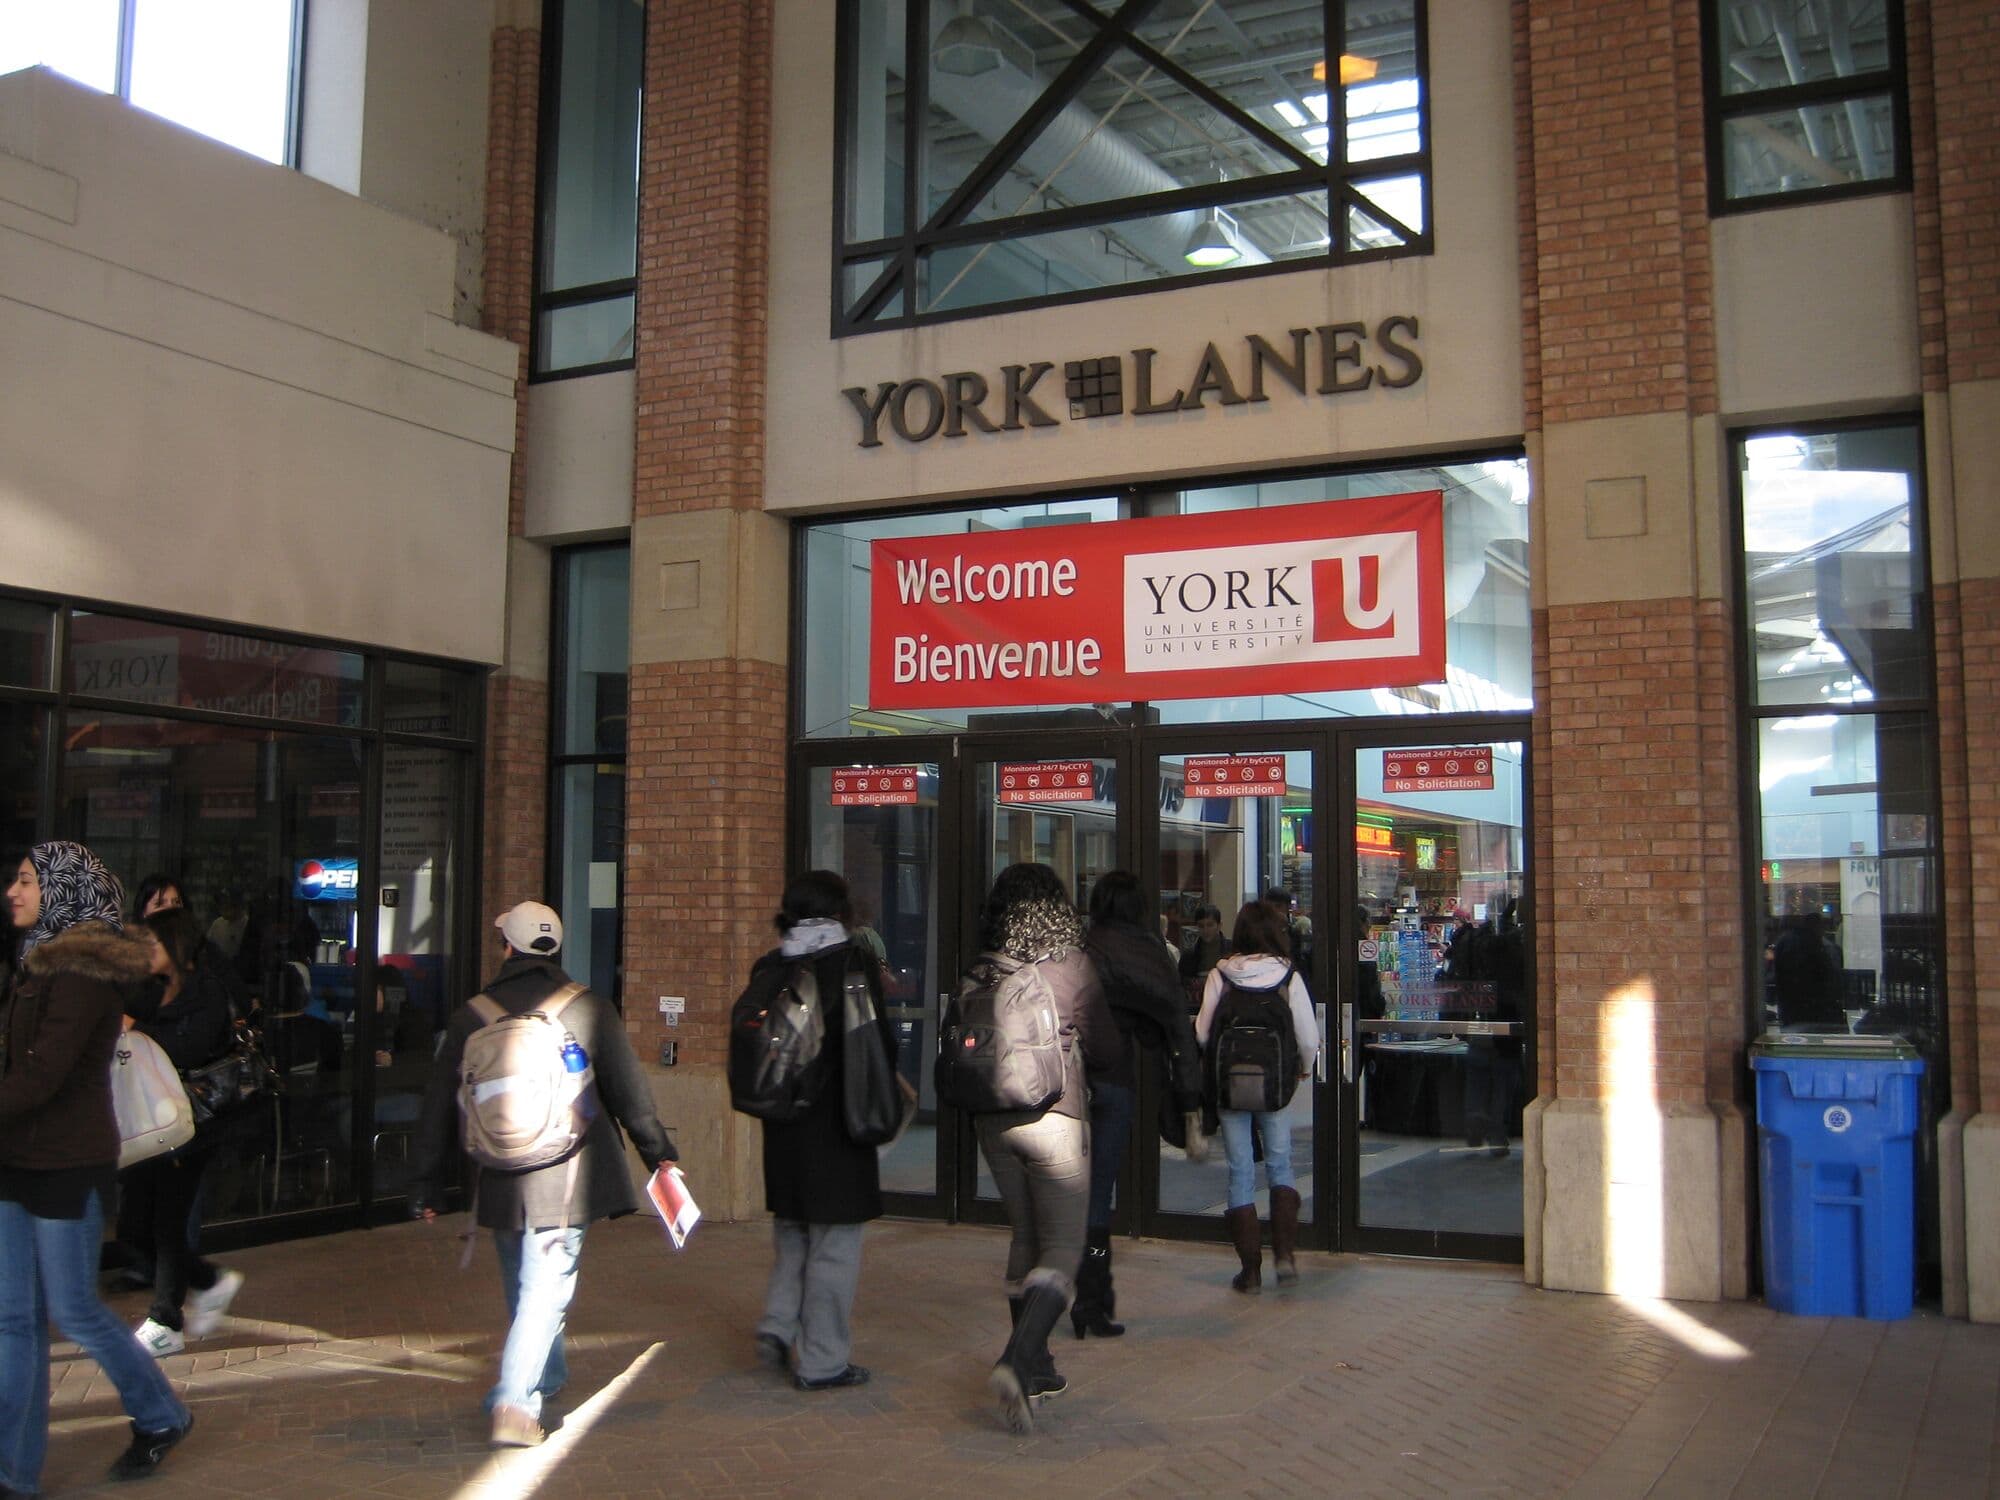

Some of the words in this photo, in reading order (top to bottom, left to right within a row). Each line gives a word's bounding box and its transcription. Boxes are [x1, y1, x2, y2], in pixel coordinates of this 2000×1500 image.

[842, 362, 1060, 448] YORK
[1131, 316, 1423, 416] LANES
[896, 554, 1078, 605] Welcome
[1142, 565, 1301, 616] YORK
[1144, 614, 1303, 636] UNIVERSITÉ
[1144, 634, 1303, 655] UNIVERSITY
[894, 633, 1101, 683] Bienvenue
[1189, 758, 1229, 766] Monitored
[1230, 757, 1248, 765] 24/7
[1388, 751, 1432, 759] Monitored
[1433, 750, 1452, 758] 24/7
[1195, 786, 1210, 795] No
[1216, 785, 1274, 795] Solicitation
[1395, 781, 1411, 790] No
[1417, 779, 1481, 789] Solicitation
[841, 795, 853, 803] No
[858, 794, 908, 803] Solicitation
[1011, 792, 1023, 800] No
[1029, 790, 1083, 800] Solicitation
